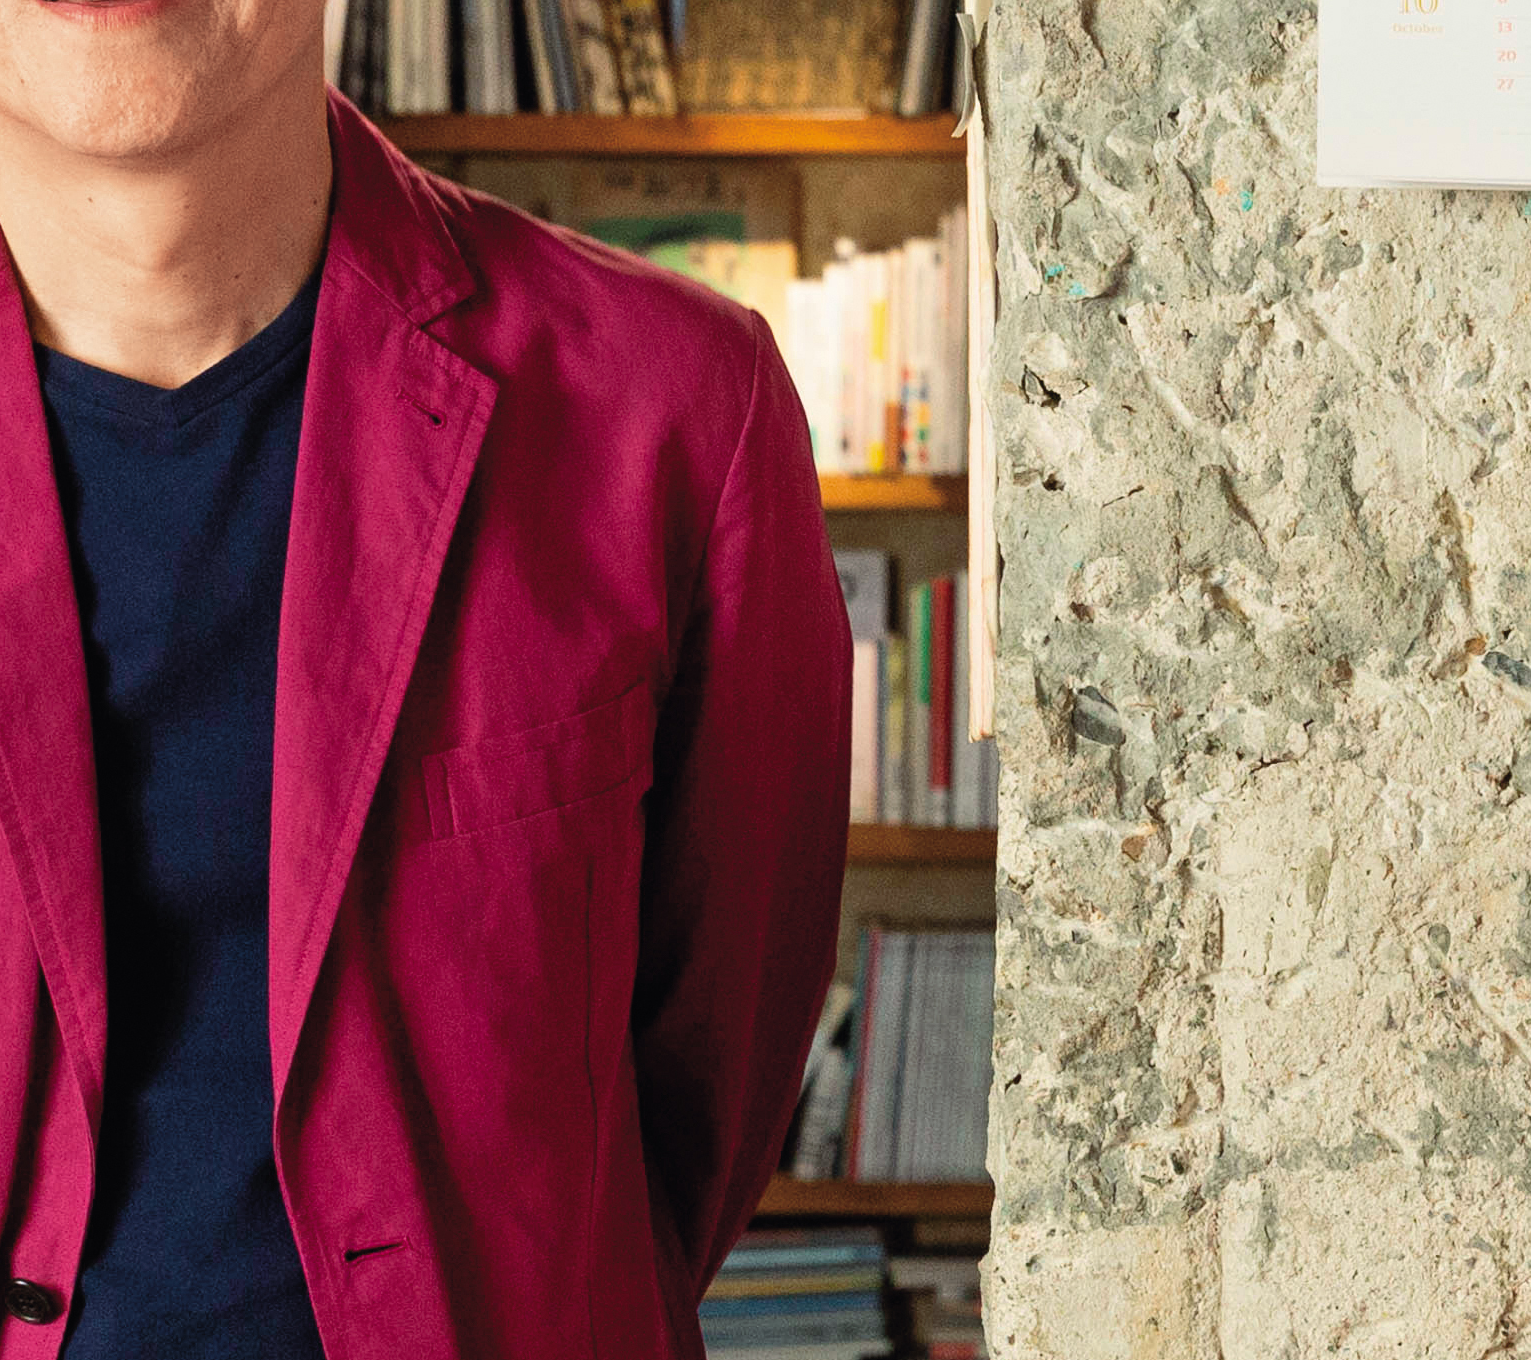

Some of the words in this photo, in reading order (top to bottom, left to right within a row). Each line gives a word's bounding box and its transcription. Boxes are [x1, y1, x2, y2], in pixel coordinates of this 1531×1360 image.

[1497, 22, 1513, 32] 13
[1497, 51, 1518, 62] 20
[1497, 79, 1515, 90] 27
